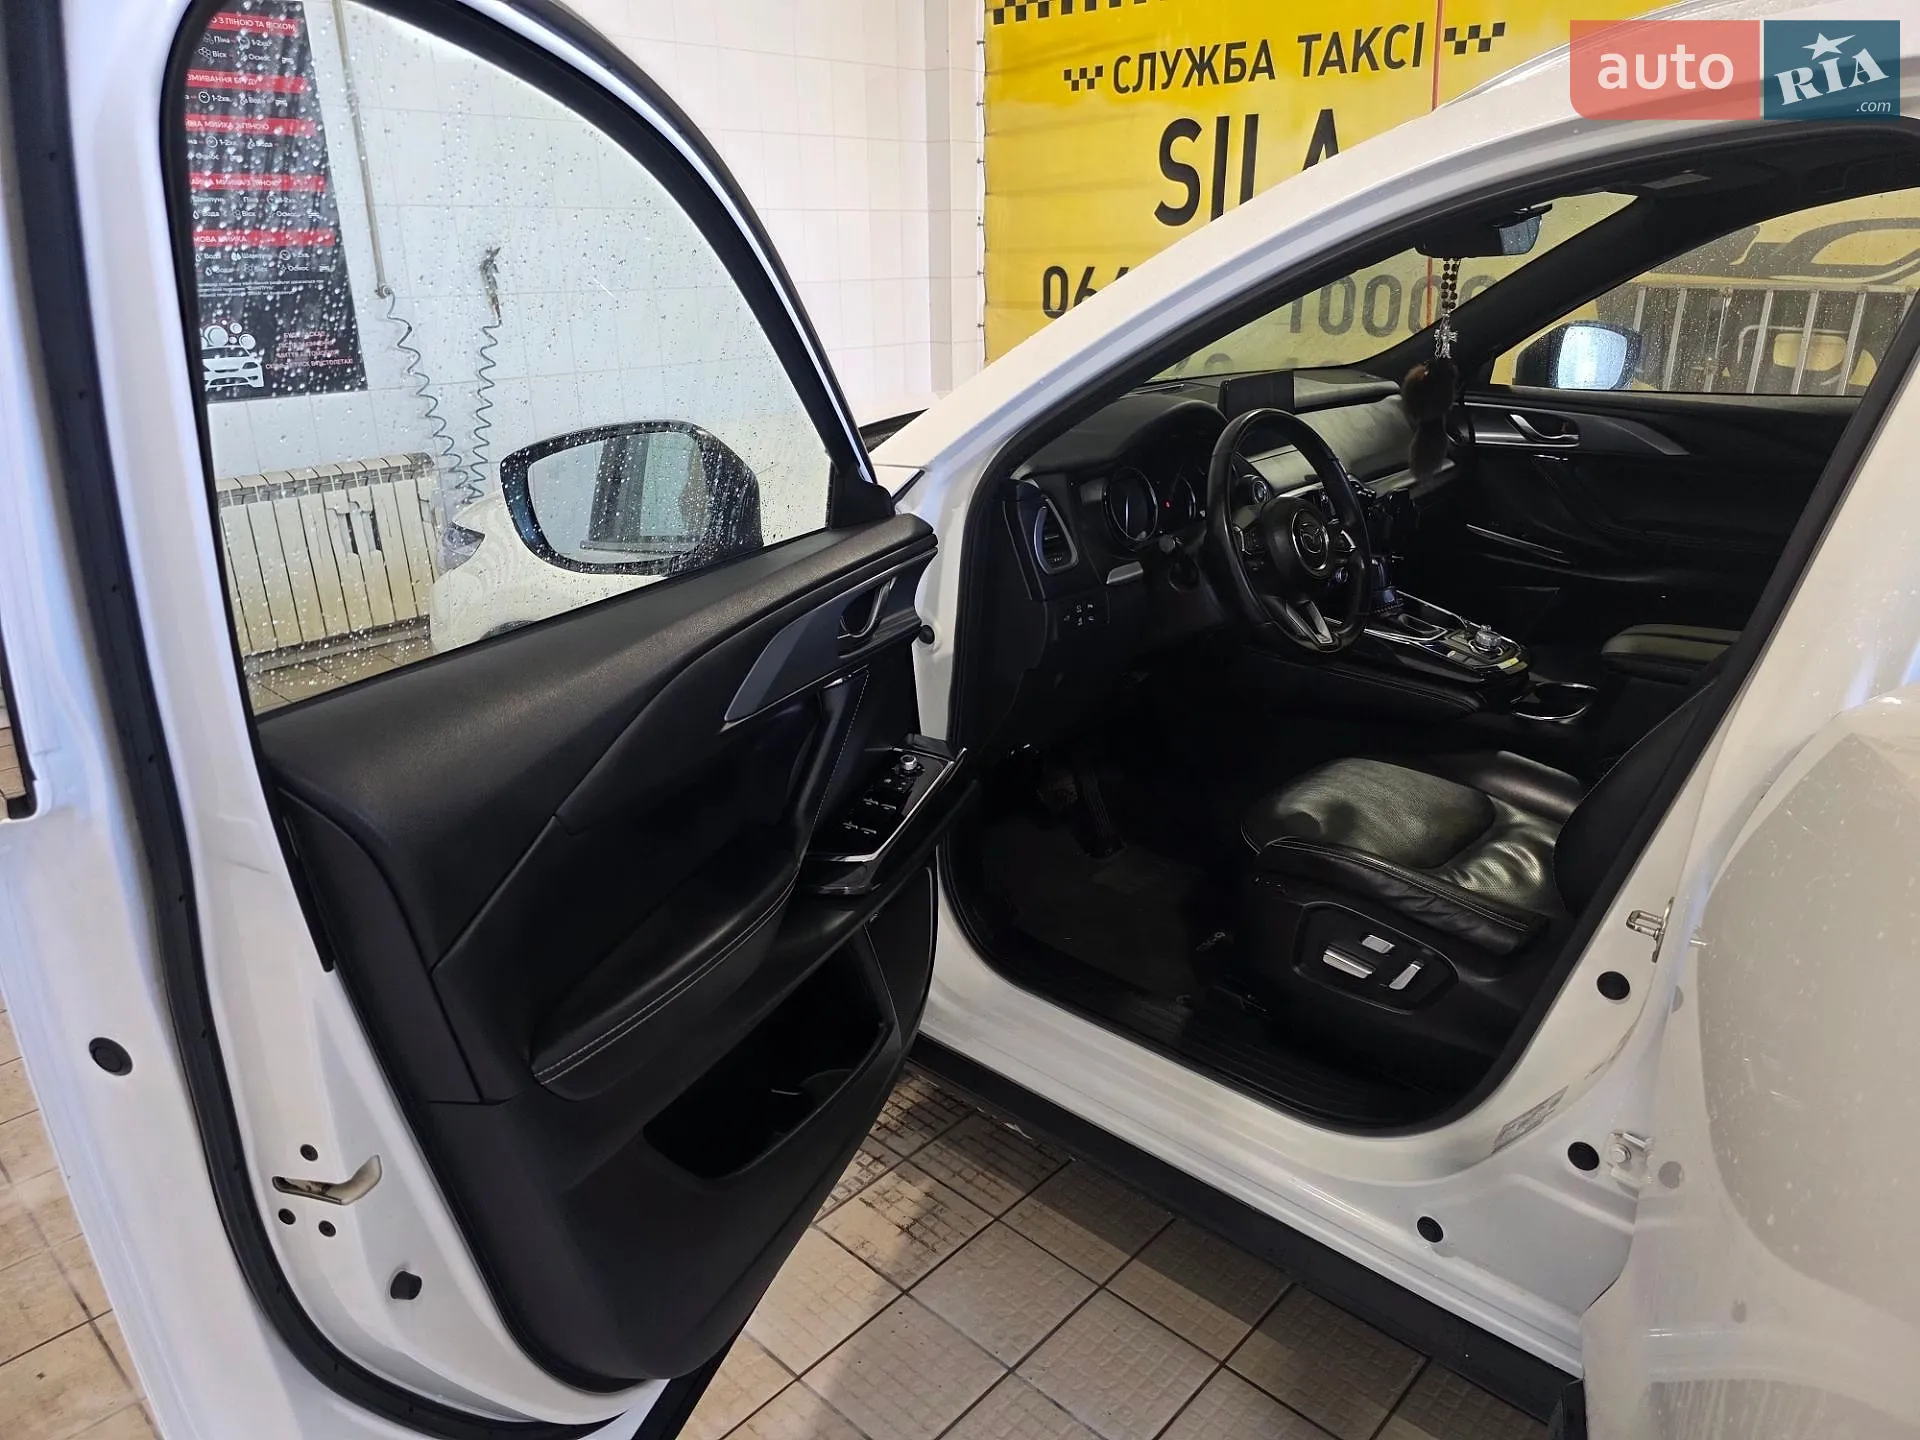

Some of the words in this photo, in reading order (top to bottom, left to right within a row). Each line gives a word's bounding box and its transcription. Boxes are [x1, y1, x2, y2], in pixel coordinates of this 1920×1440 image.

[1113, 39, 1275, 94] СЛУЖБА
[1297, 22, 1424, 77] ТАКСІ
[1042, 265, 1129, 318] 06
